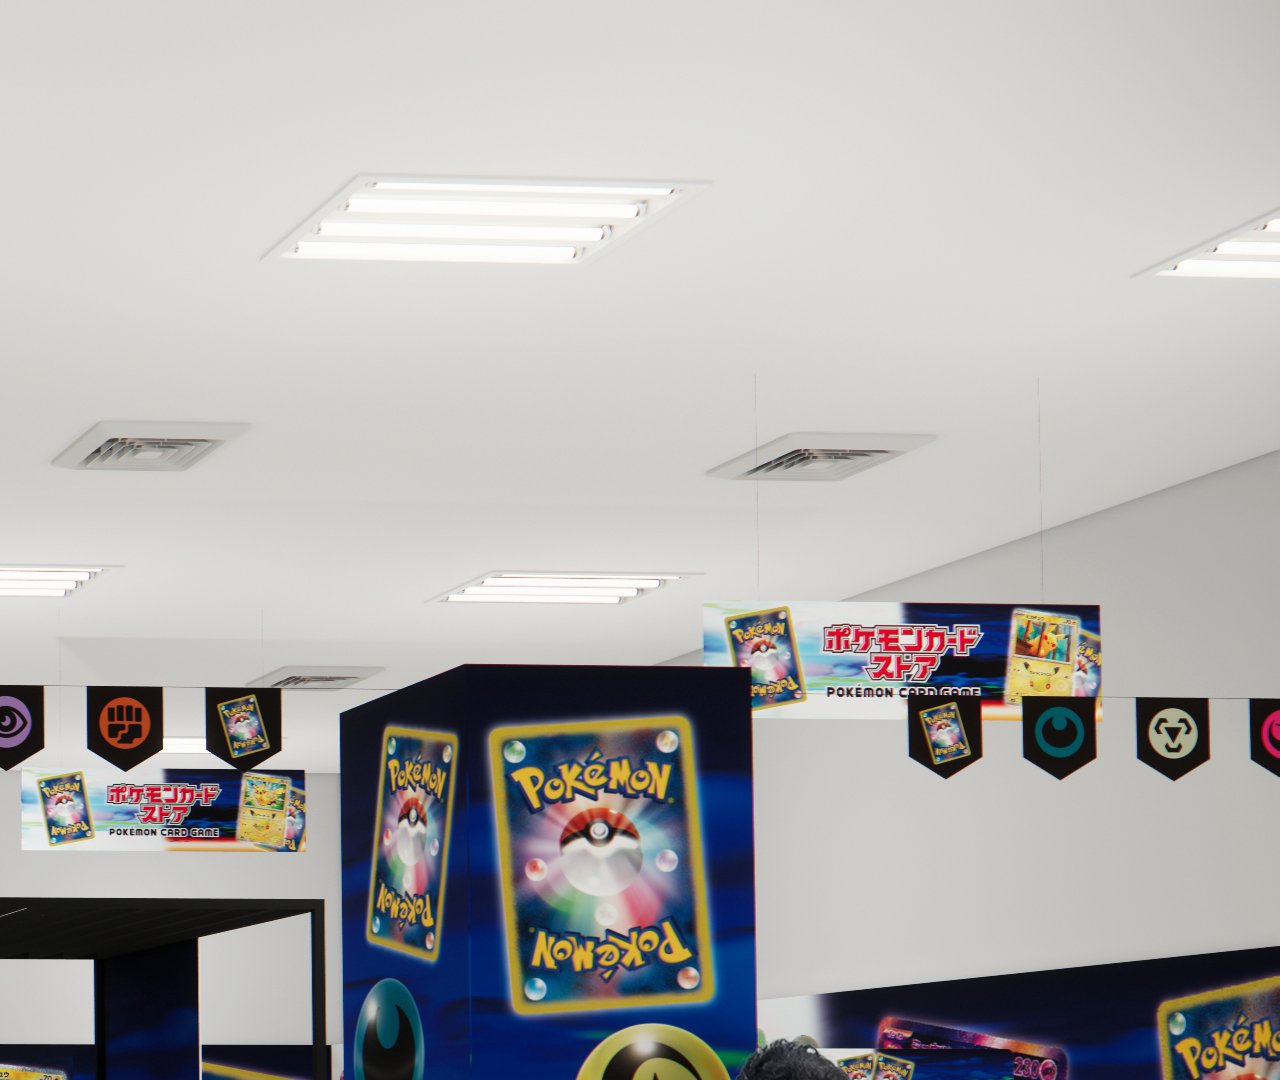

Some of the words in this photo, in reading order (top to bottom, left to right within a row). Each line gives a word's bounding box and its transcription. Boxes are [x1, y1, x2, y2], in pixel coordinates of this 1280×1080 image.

[822, 624, 984, 655] ポケモンカード
[864, 654, 943, 682] ストア
[899, 688, 936, 697] CARD
[940, 688, 981, 697] GAME
[510, 748, 673, 814] Pokémon
[106, 783, 223, 806] ポケモンカード
[136, 804, 190, 825] ストア
[161, 828, 189, 837] CARD
[192, 828, 220, 837] GAME
